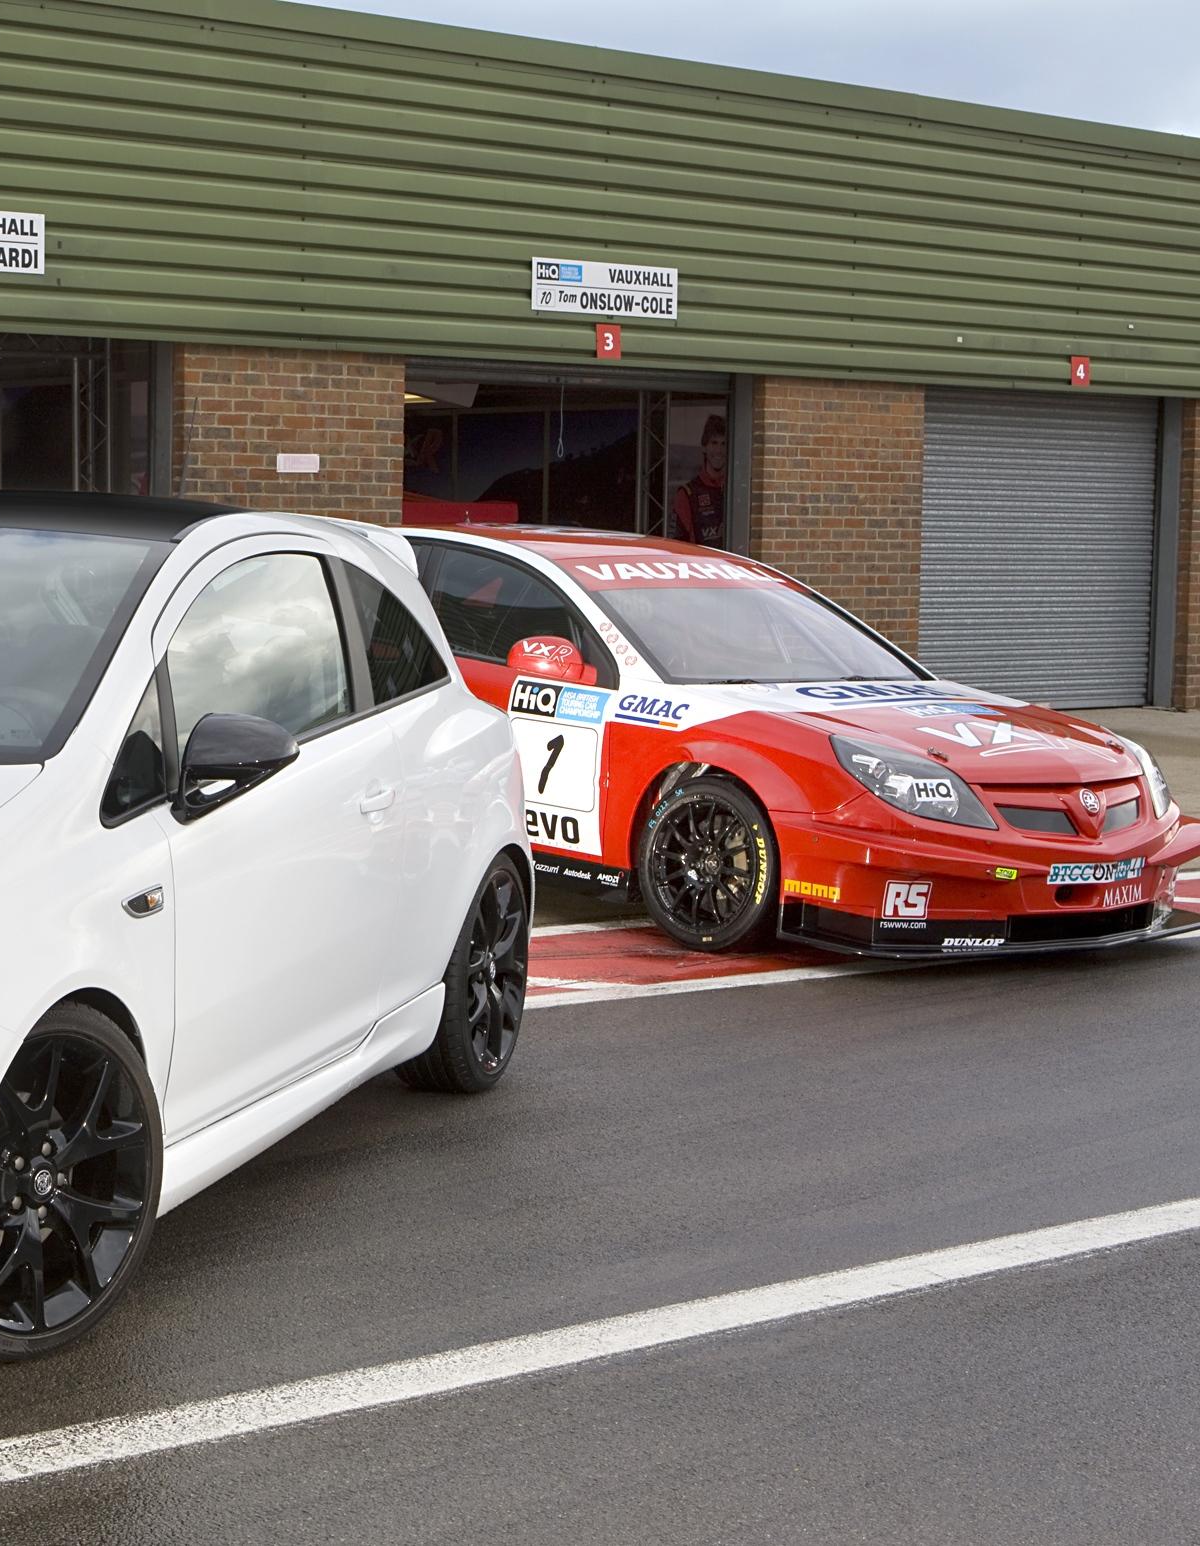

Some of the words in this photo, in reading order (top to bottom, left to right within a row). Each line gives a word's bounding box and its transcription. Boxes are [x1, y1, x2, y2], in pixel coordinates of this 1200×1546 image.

[537, 264, 559, 279] HiQ
[608, 268, 673, 288] VAUXHALL
[540, 290, 552, 305] 10
[558, 290, 577, 304] Tom
[580, 294, 673, 315] ONSLOW-COLE
[604, 332, 614, 351] 3
[1076, 363, 1085, 380] 4
[576, 561, 787, 584] VAUXHALL
[522, 641, 572, 667] VXR
[513, 684, 557, 713] HiQ
[618, 694, 690, 720] GMAC
[538, 734, 564, 794] 1
[915, 782, 952, 798] HiQ
[563, 868, 591, 880] Autodesk
[755, 837, 767, 905] DUNLOP
[784, 879, 840, 900] momo
[885, 883, 929, 917] RS
[1102, 883, 1142, 907] MAXIM
[880, 920, 926, 929] rswww.com
[942, 937, 1004, 947] DUNLOP
